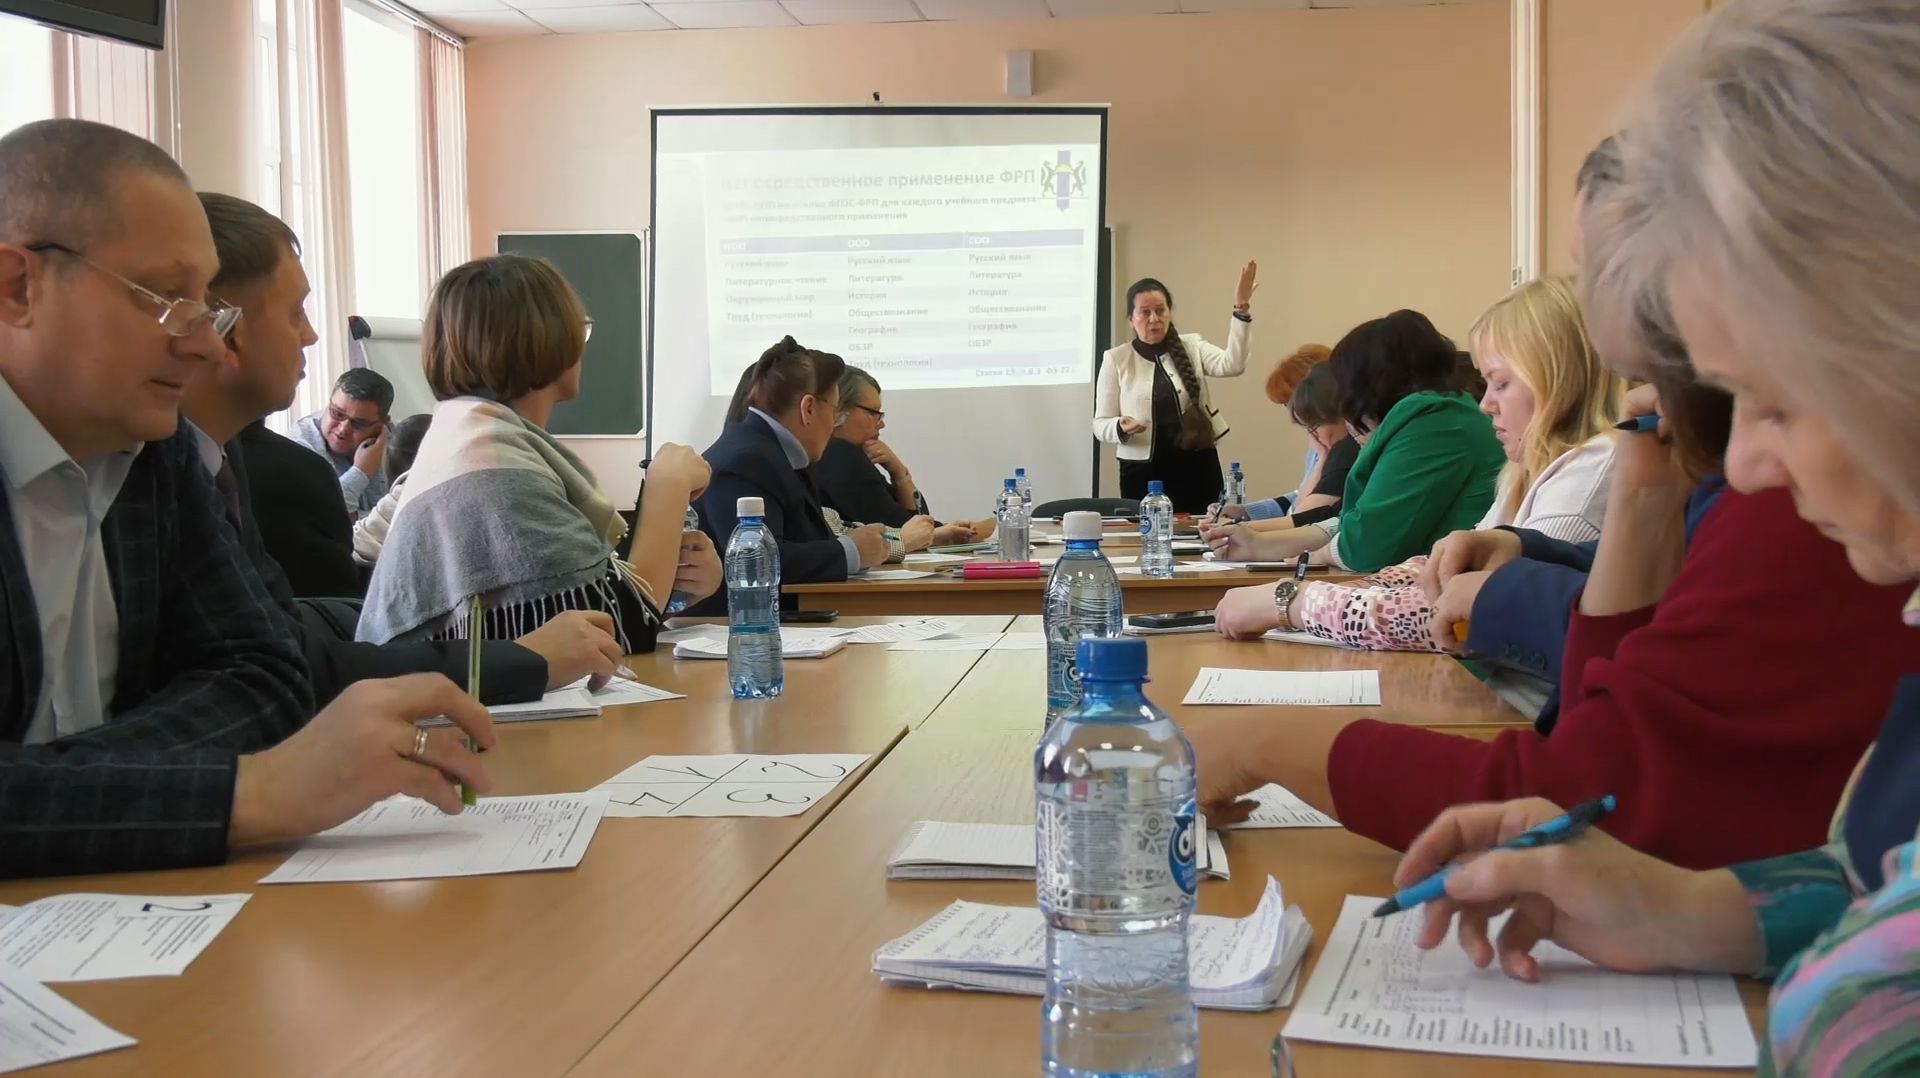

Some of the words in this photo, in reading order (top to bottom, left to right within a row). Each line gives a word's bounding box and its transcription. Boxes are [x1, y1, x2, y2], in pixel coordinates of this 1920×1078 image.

[888, 172, 994, 189] применение
[1000, 169, 1035, 184] ФРП
[848, 256, 886, 267] Русский
[968, 253, 1006, 264] Русский
[848, 274, 903, 284] Литература
[969, 271, 1022, 281] Литература
[848, 291, 887, 302] История
[848, 324, 898, 336] География
